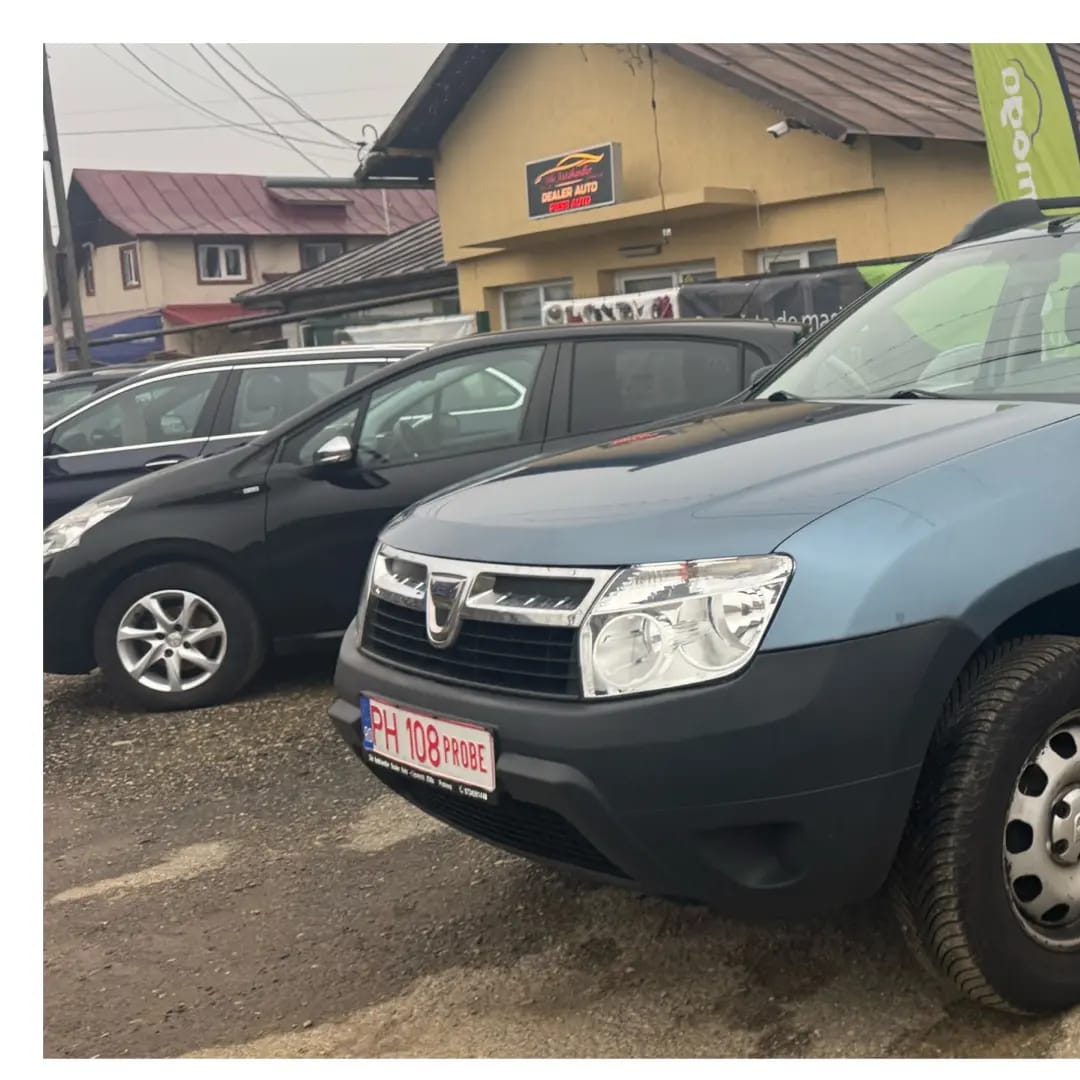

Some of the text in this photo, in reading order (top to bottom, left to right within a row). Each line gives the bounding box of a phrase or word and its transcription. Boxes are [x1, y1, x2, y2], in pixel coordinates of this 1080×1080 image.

[541, 181, 598, 203] DEALER AUTO
[370, 704, 487, 773] PH 108 PROBE
